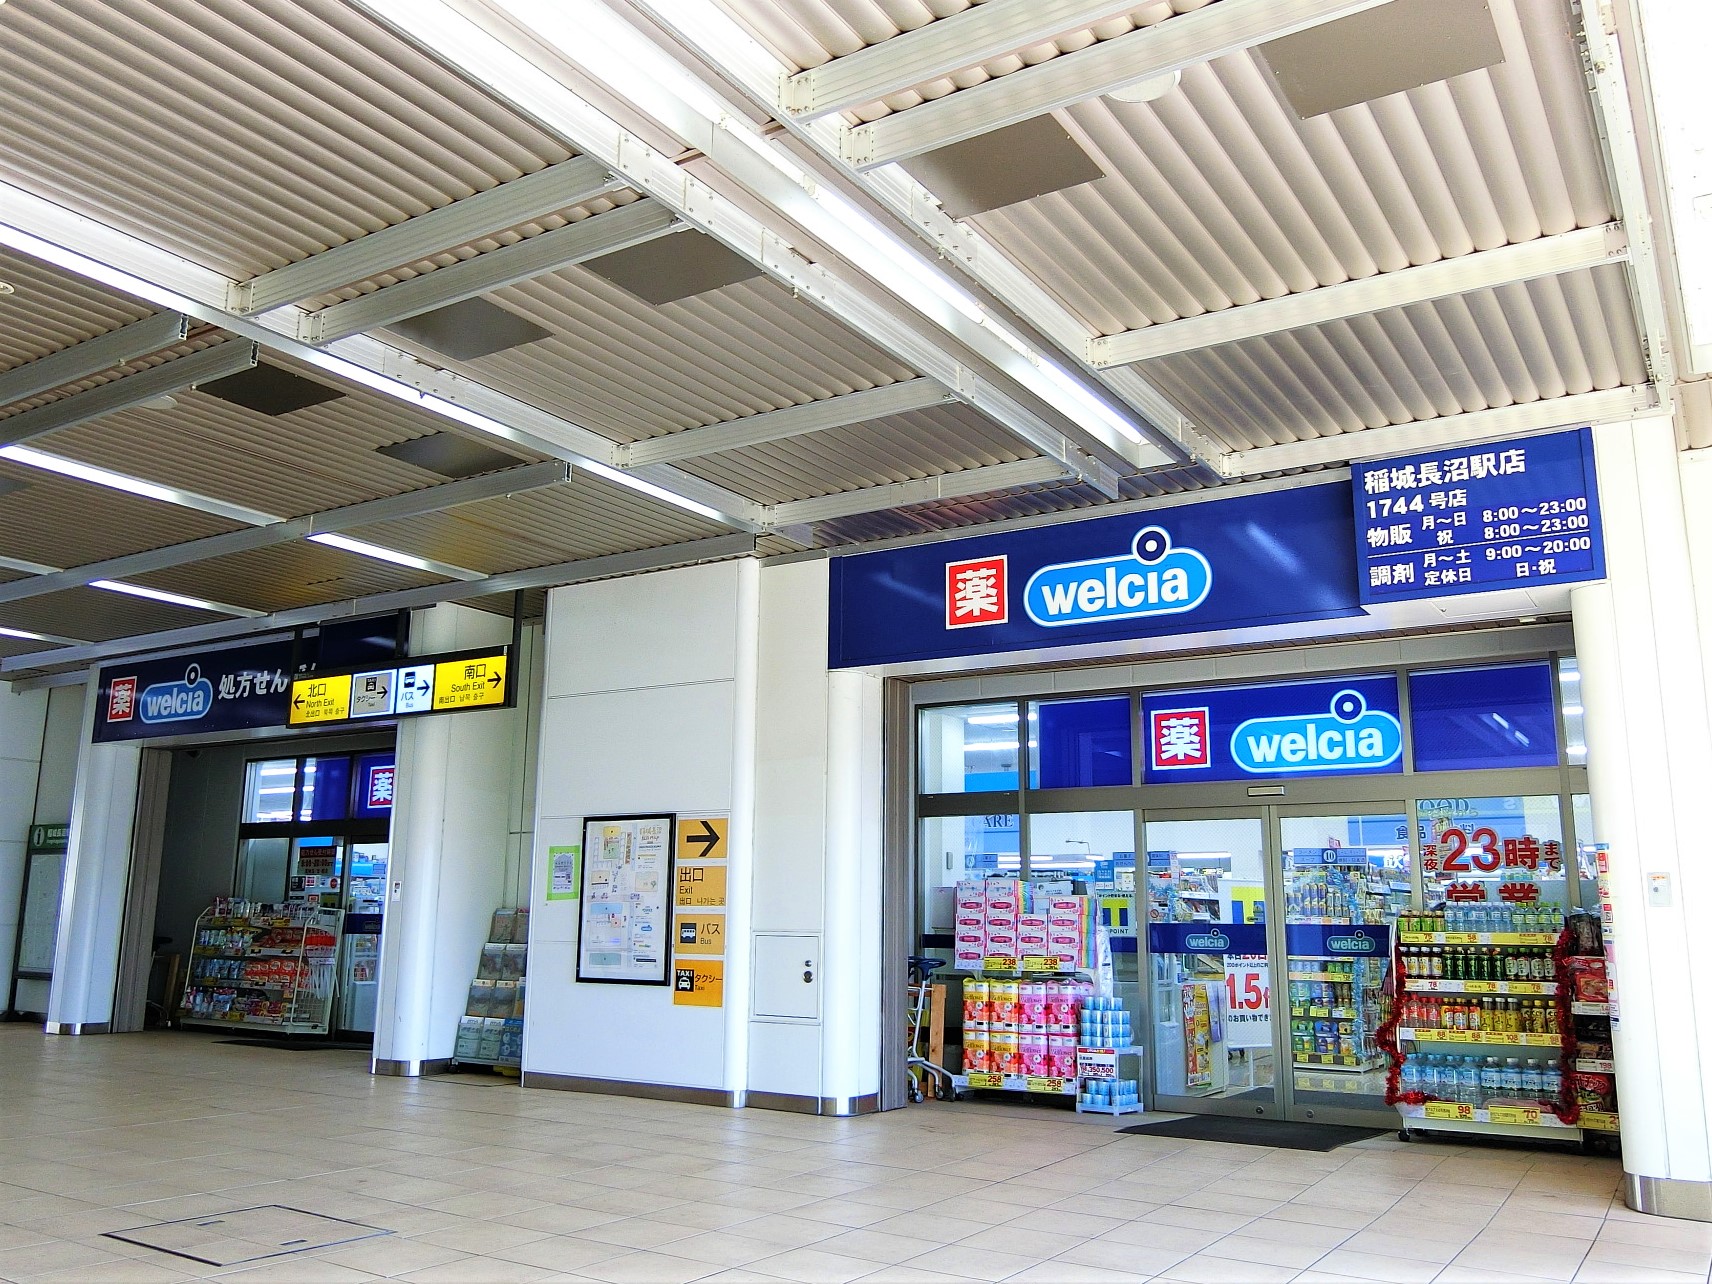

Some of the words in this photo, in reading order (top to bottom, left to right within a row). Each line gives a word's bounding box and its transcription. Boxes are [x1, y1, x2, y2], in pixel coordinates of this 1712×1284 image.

[1364, 449, 1526, 495] 稲城長沼駅店
[1367, 523, 1412, 548] 物販
[1437, 530, 1454, 546] 祝
[1370, 563, 1414, 587] 調剤
[1424, 567, 1472, 586] 定休日
[954, 567, 999, 618] 薬
[1040, 567, 1189, 616] welcia
[464, 664, 487, 680] 南口
[218, 663, 317, 700] 処方せん
[451, 683, 470, 693] South
[473, 681, 485, 690] Exit
[308, 683, 326, 698] 北口
[400, 691, 414, 701] バス
[112, 684, 133, 715] 薬
[147, 687, 204, 717] welcia
[305, 700, 322, 709] North
[323, 698, 335, 707] Exit
[1159, 718, 1202, 760] 薬
[1247, 723, 1384, 762] welcia
[373, 772, 393, 802] 薬
[1325, 851, 1335, 861] 10
[680, 867, 704, 883] 出口
[680, 886, 693, 894] Exit
[680, 897, 692, 905] 出口
[700, 923, 721, 935] バス
[1189, 936, 1224, 948] welcia
[1330, 936, 1369, 951] welcia
[1002, 958, 1016, 966] 238
[1043, 958, 1058, 966] 238
[695, 974, 723, 983] タクシー
[1228, 1014, 1272, 1023] のお買い物でき
[987, 1075, 1002, 1083] 258
[1046, 1080, 1062, 1088] 258
[1457, 1105, 1471, 1115] 98
[1522, 1110, 1538, 1119] 70
